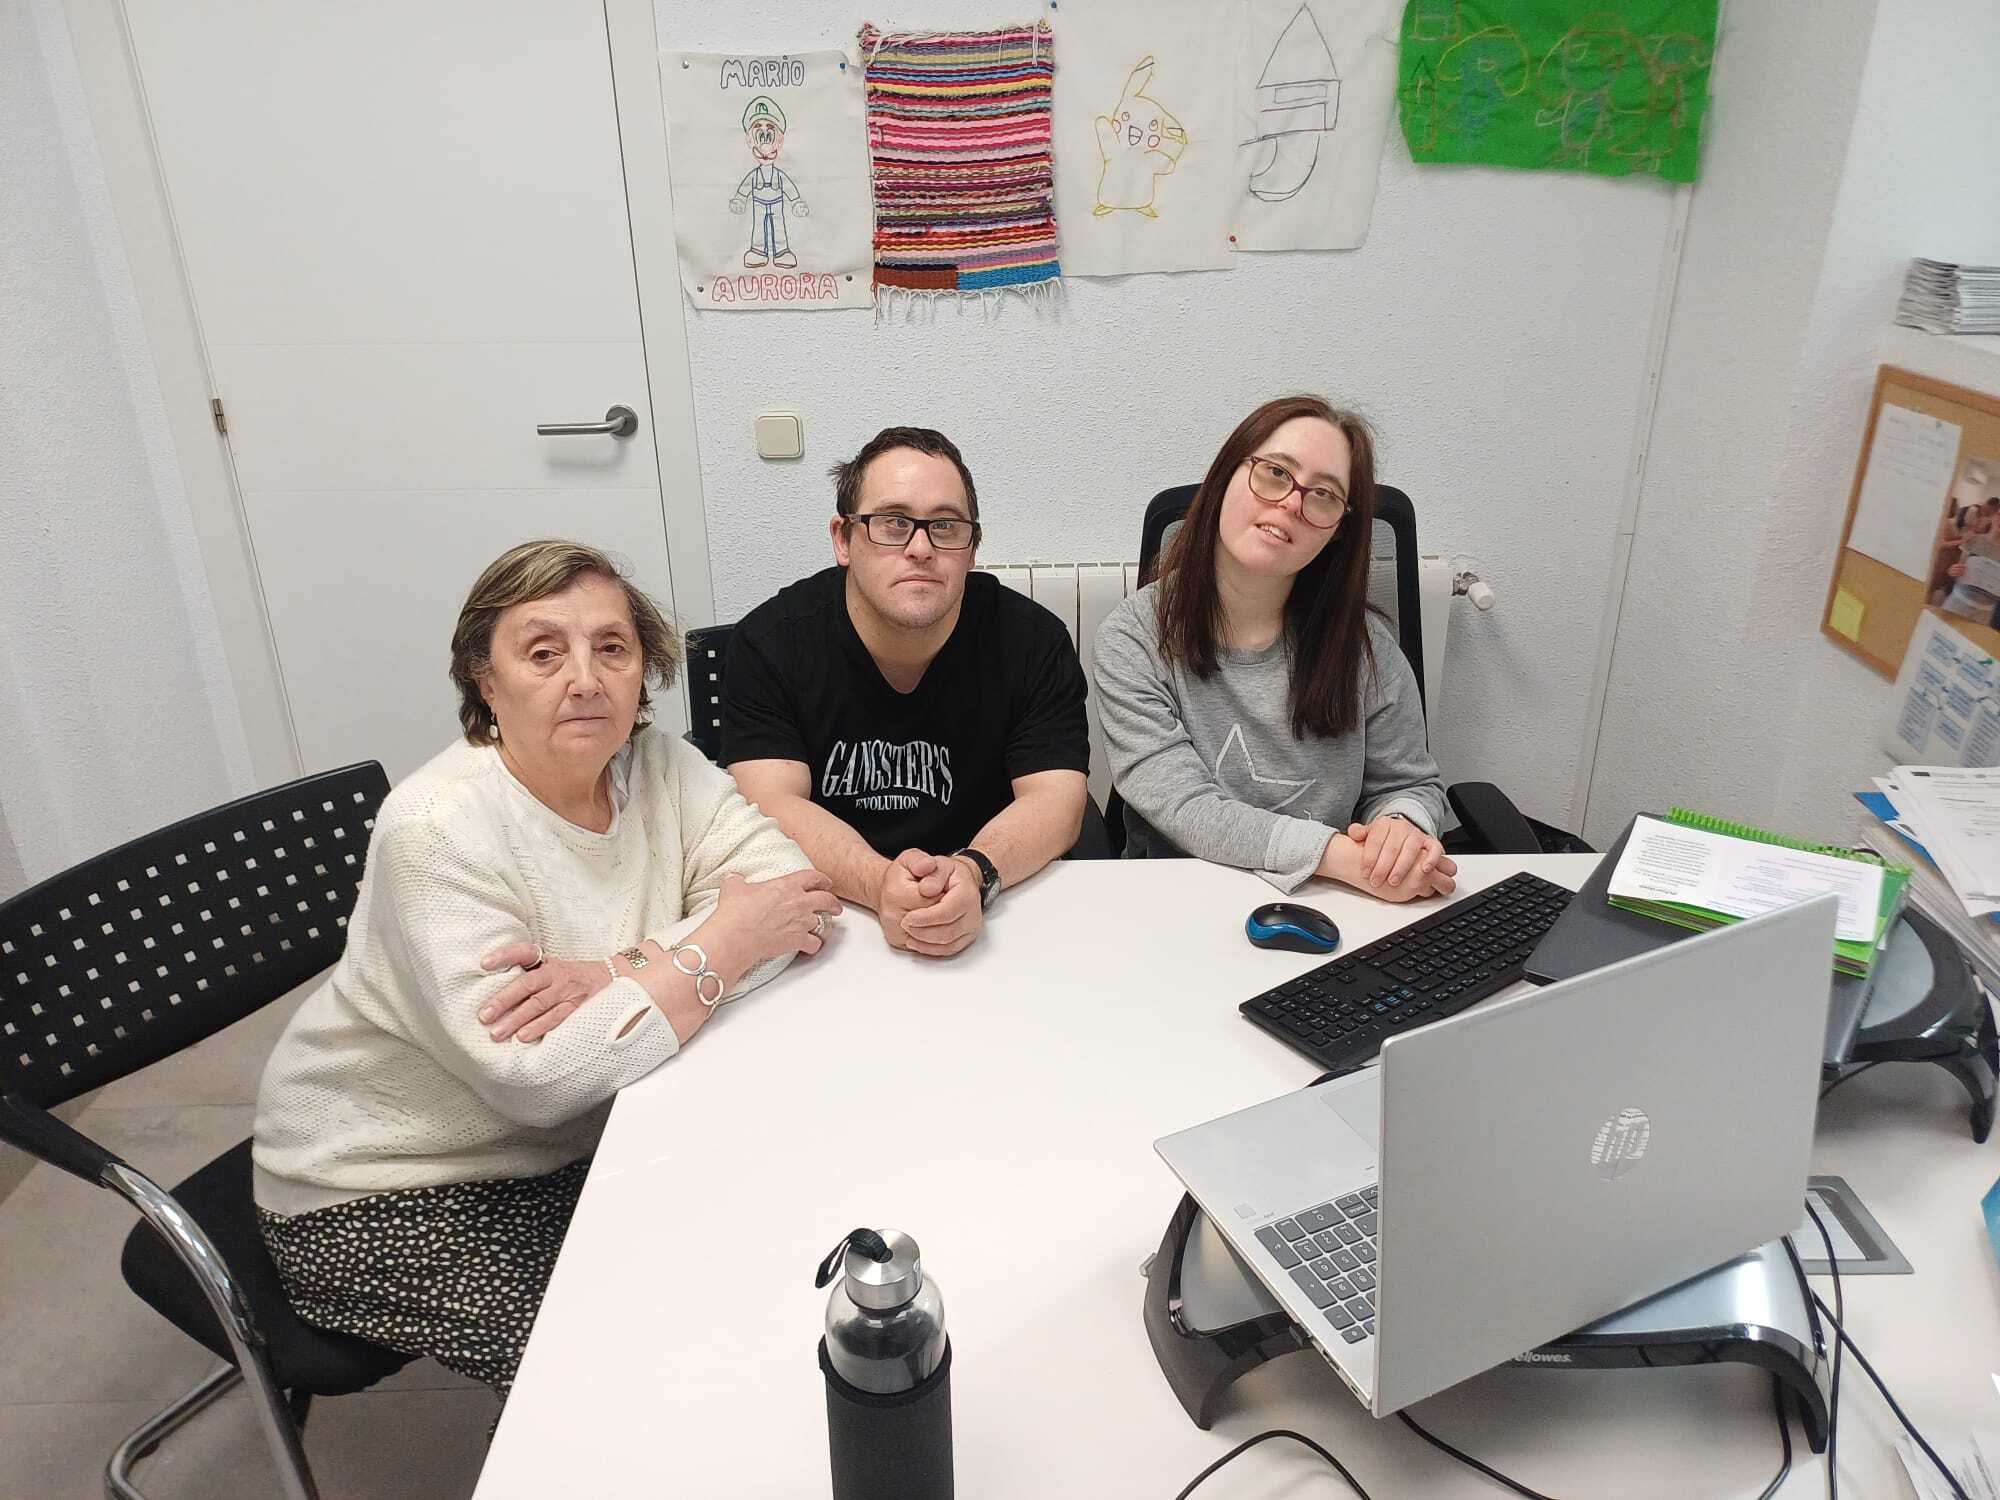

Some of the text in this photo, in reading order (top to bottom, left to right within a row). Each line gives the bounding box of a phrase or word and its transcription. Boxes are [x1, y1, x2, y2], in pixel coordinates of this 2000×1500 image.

[712, 273, 839, 301] AURORA
[821, 739, 953, 806] GANGSTER'S
[856, 796, 919, 810] EVOLUTION
